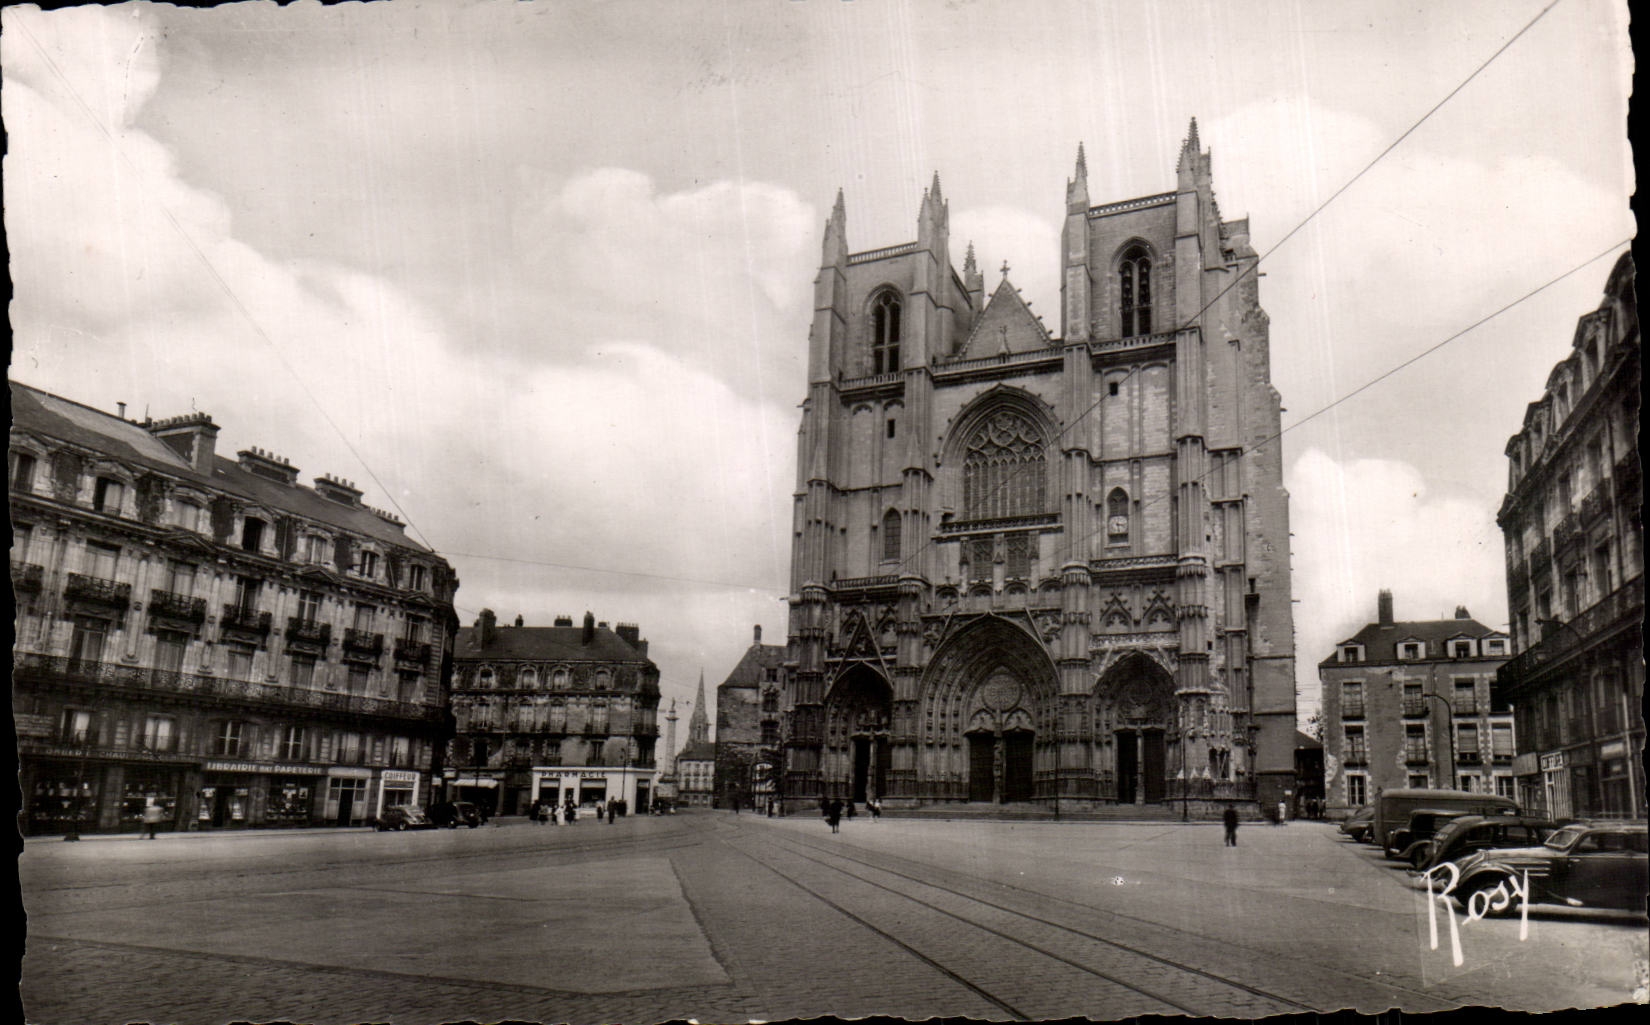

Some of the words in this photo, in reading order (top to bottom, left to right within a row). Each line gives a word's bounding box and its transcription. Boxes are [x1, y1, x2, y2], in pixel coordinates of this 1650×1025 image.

[207, 761, 258, 773] LIBRAIRIE
[274, 765, 322, 775] PAPETERIE
[384, 771, 416, 780] COIFFEUR
